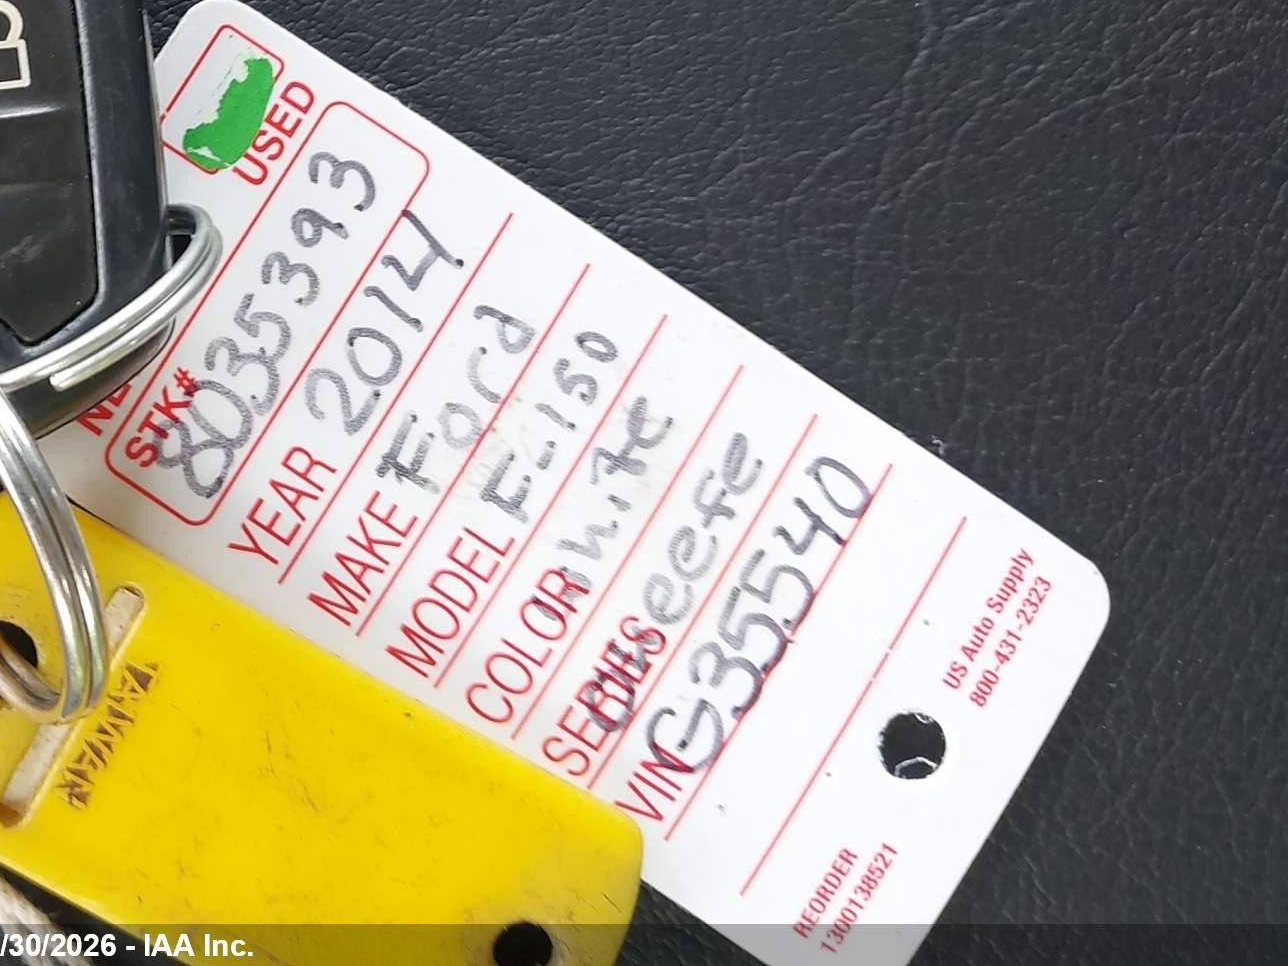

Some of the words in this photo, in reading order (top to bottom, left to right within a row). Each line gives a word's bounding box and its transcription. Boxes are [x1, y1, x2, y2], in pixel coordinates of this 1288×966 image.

[232, 81, 316, 185] USED
[154, 151, 376, 498] 8035393
[305, 208, 466, 436] 2014
[126, 367, 198, 468] STK#
[376, 305, 535, 494] Ford
[479, 330, 618, 523] F-150
[228, 445, 337, 566] YEAR
[308, 491, 418, 627] MAKE
[384, 526, 515, 678] MODEL
[464, 568, 590, 724] COLOR
[646, 455, 872, 774] G35540
[941, 661, 970, 691] US
[965, 613, 995, 661] Auto
[987, 547, 1035, 613] Supply
[969, 576, 1053, 708] 800-431-2323
[542, 615, 667, 777] SERIES
[614, 744, 697, 822] VIN
[792, 846, 859, 939] REORDER
[820, 842, 899, 954] 1300138521
